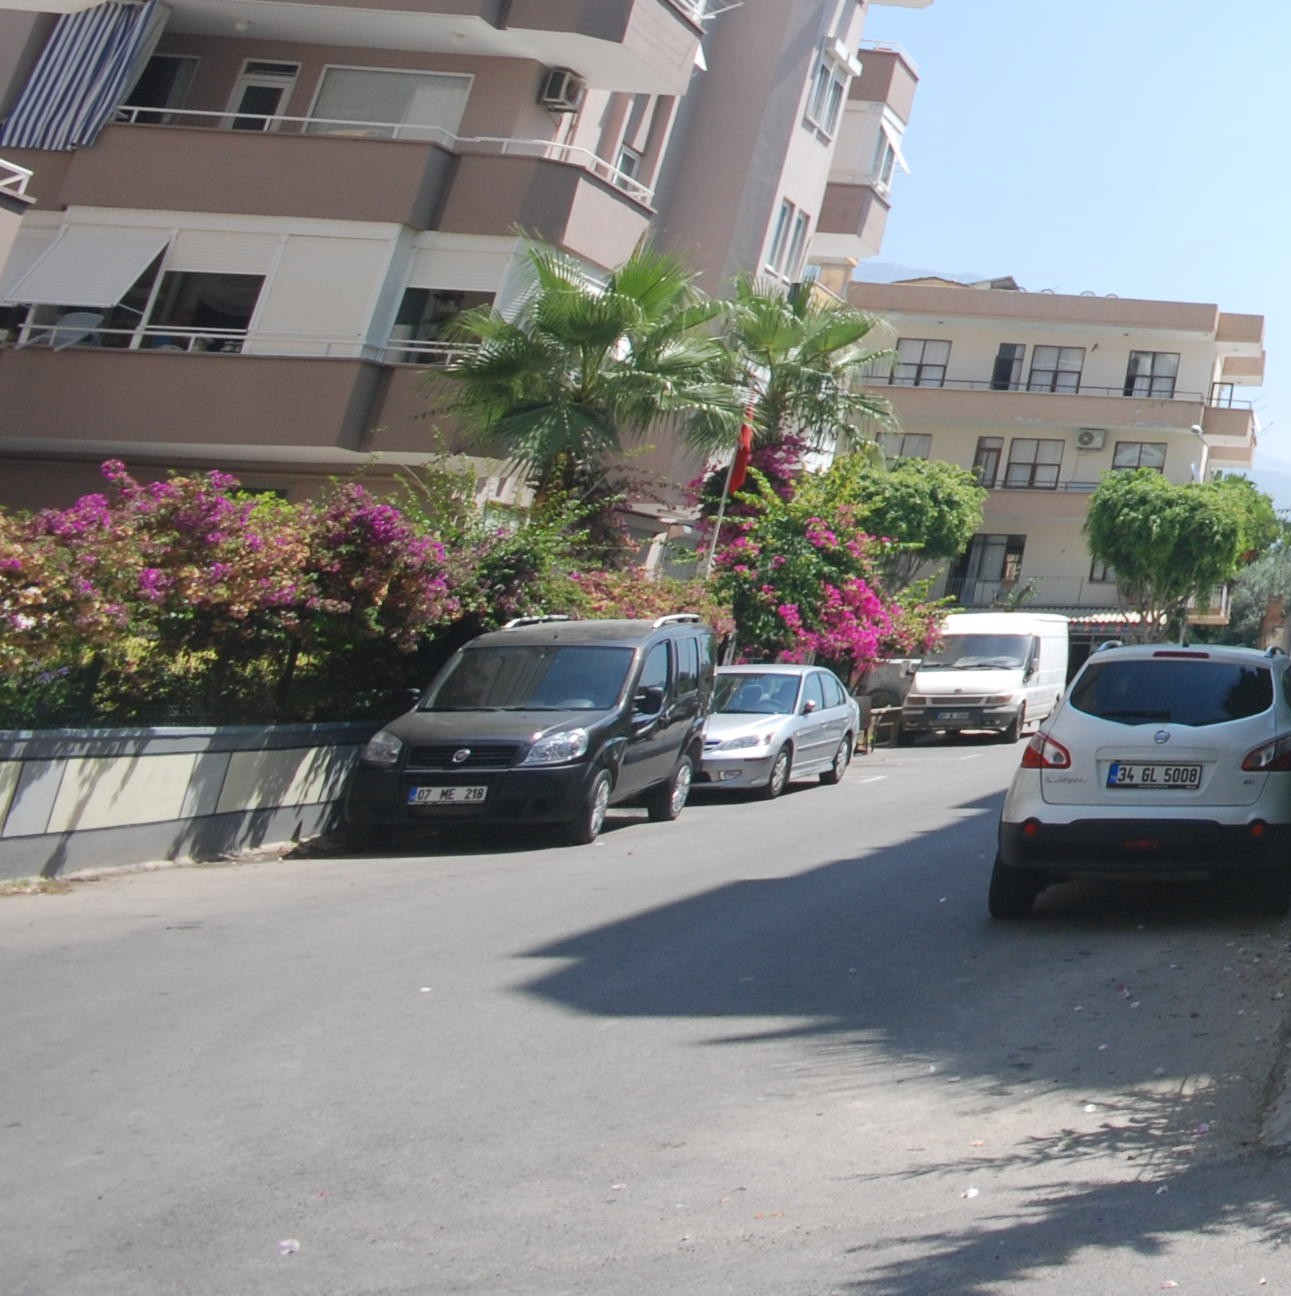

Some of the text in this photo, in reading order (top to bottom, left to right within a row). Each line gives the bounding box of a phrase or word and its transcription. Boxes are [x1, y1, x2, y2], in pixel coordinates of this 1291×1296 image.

[1118, 767, 1198, 784] 34 GL 5008
[417, 789, 432, 800] 07
[464, 787, 484, 800] 218
